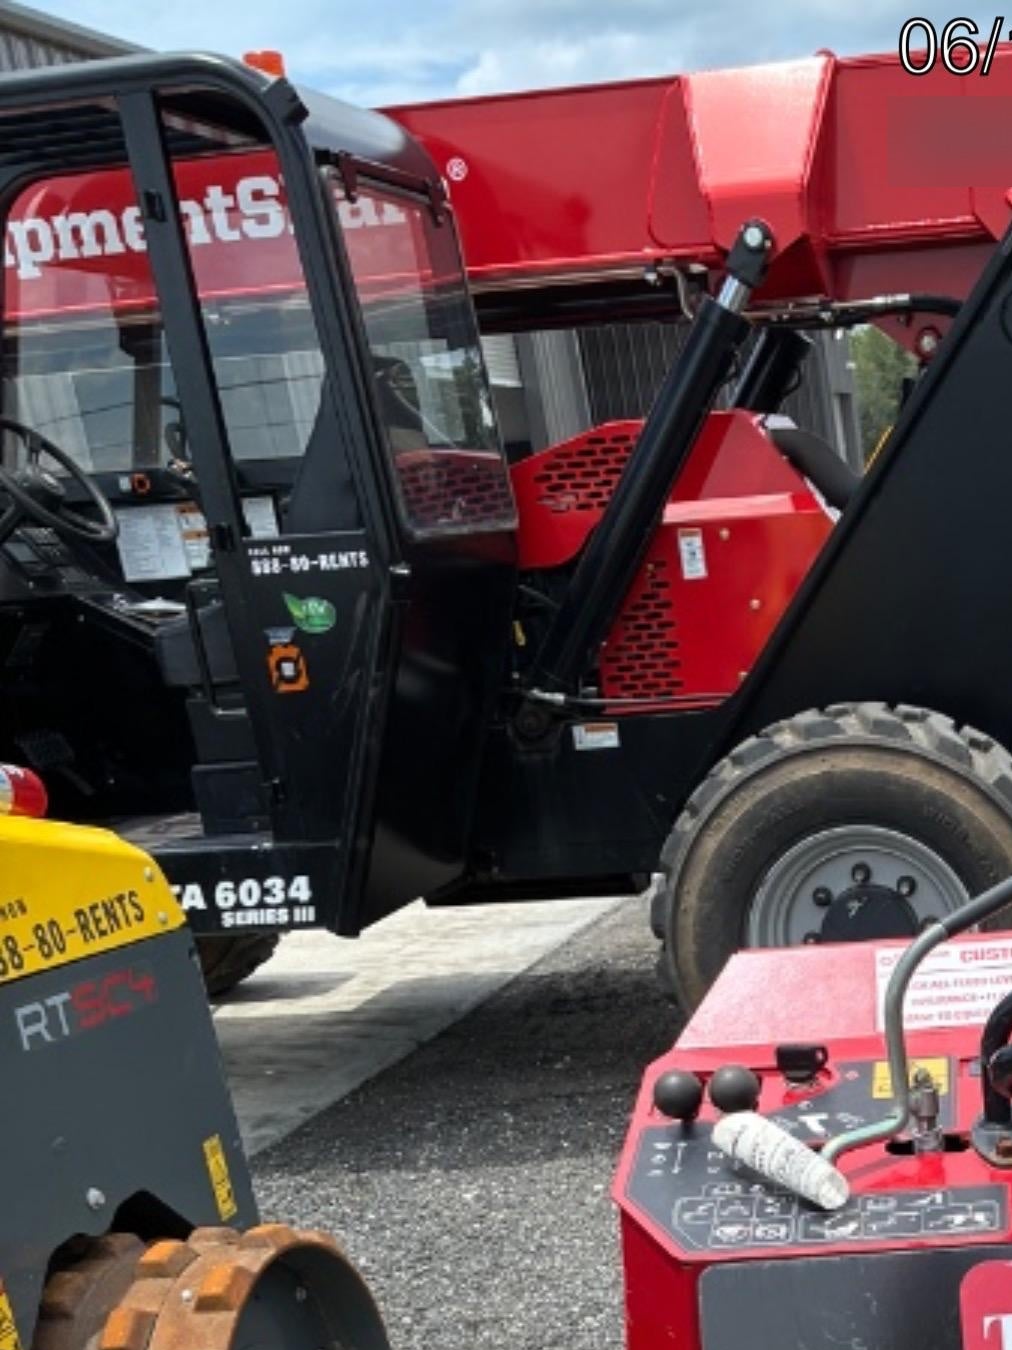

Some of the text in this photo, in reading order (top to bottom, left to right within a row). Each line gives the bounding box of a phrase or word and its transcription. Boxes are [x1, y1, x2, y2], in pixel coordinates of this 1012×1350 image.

[215, 875, 312, 909] 6034
[221, 905, 316, 928] SERIES III
